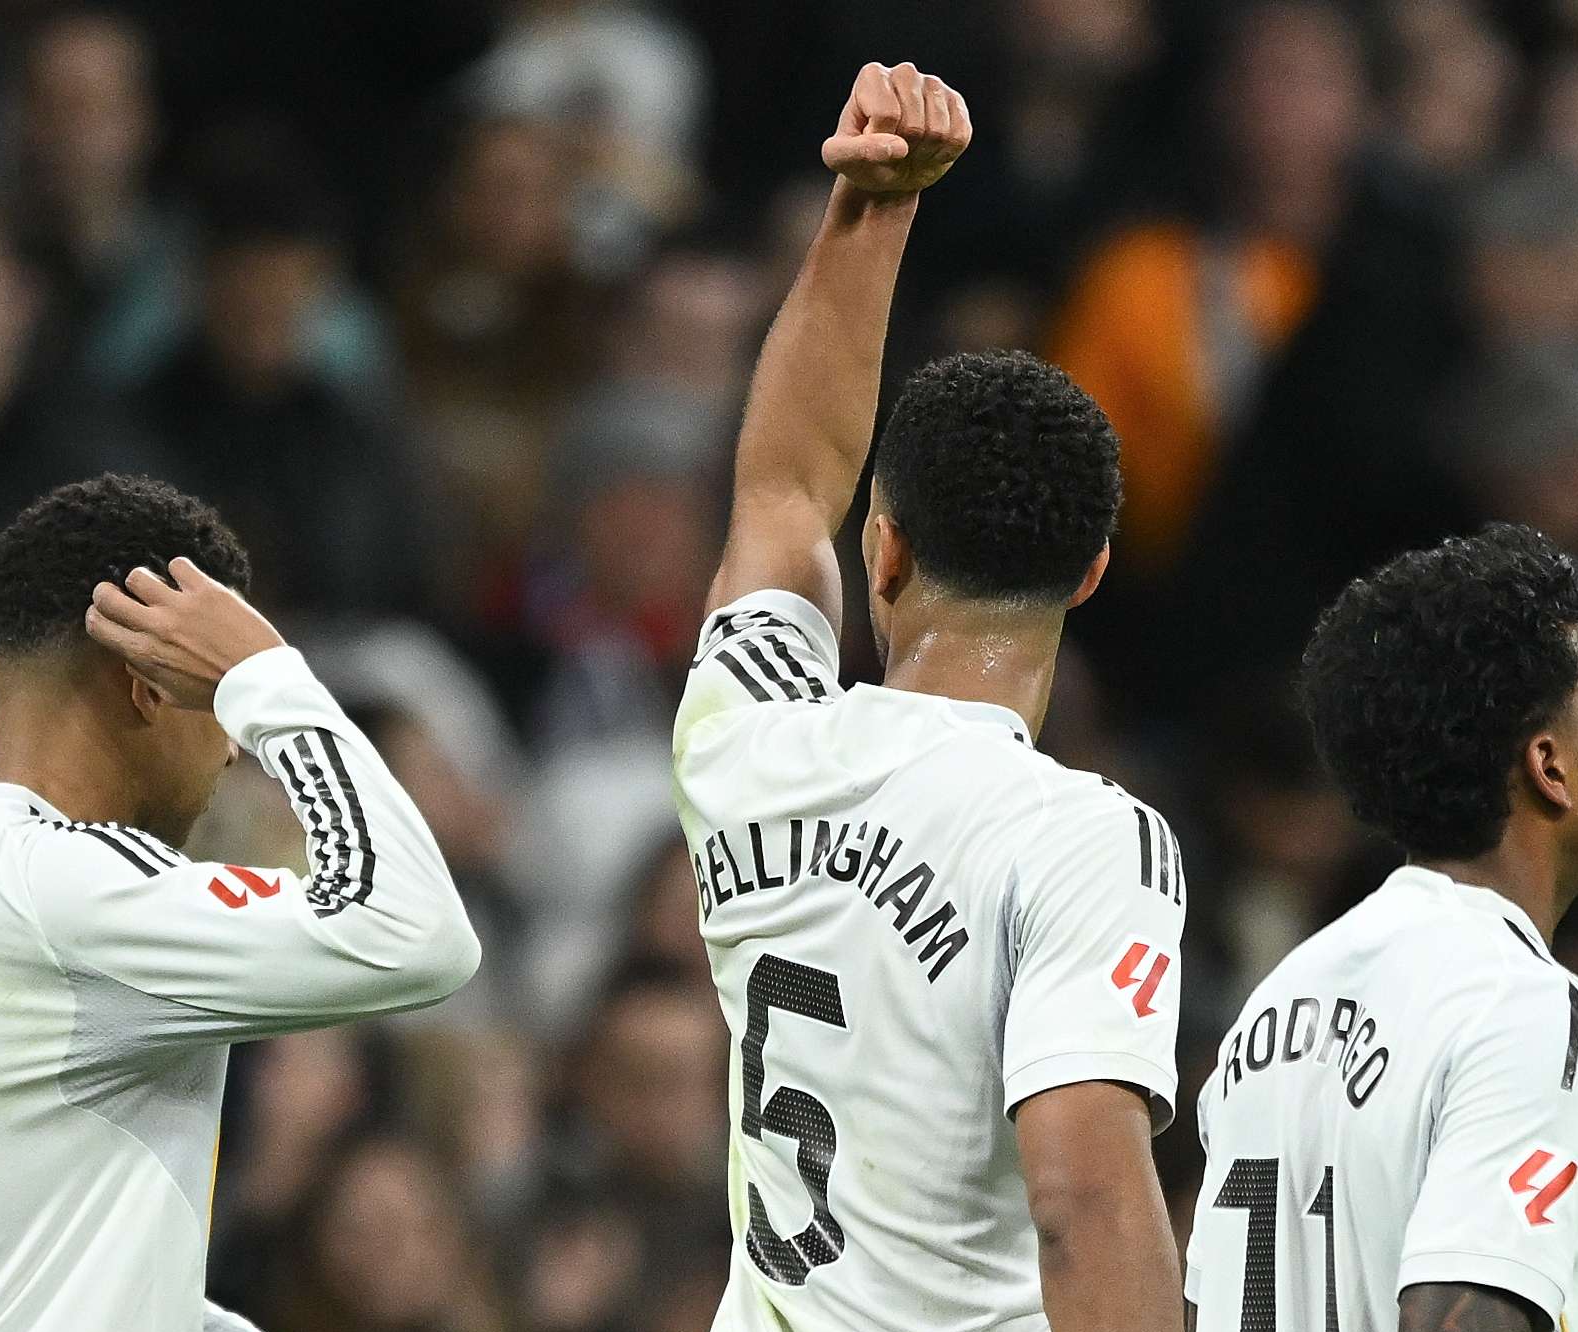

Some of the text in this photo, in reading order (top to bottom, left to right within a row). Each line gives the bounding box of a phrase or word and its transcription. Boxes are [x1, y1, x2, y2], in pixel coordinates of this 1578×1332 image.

[694, 818, 970, 985] BELLINGHAM
[741, 952, 848, 1286] 5
[1222, 996, 1390, 1110] RODRGO
